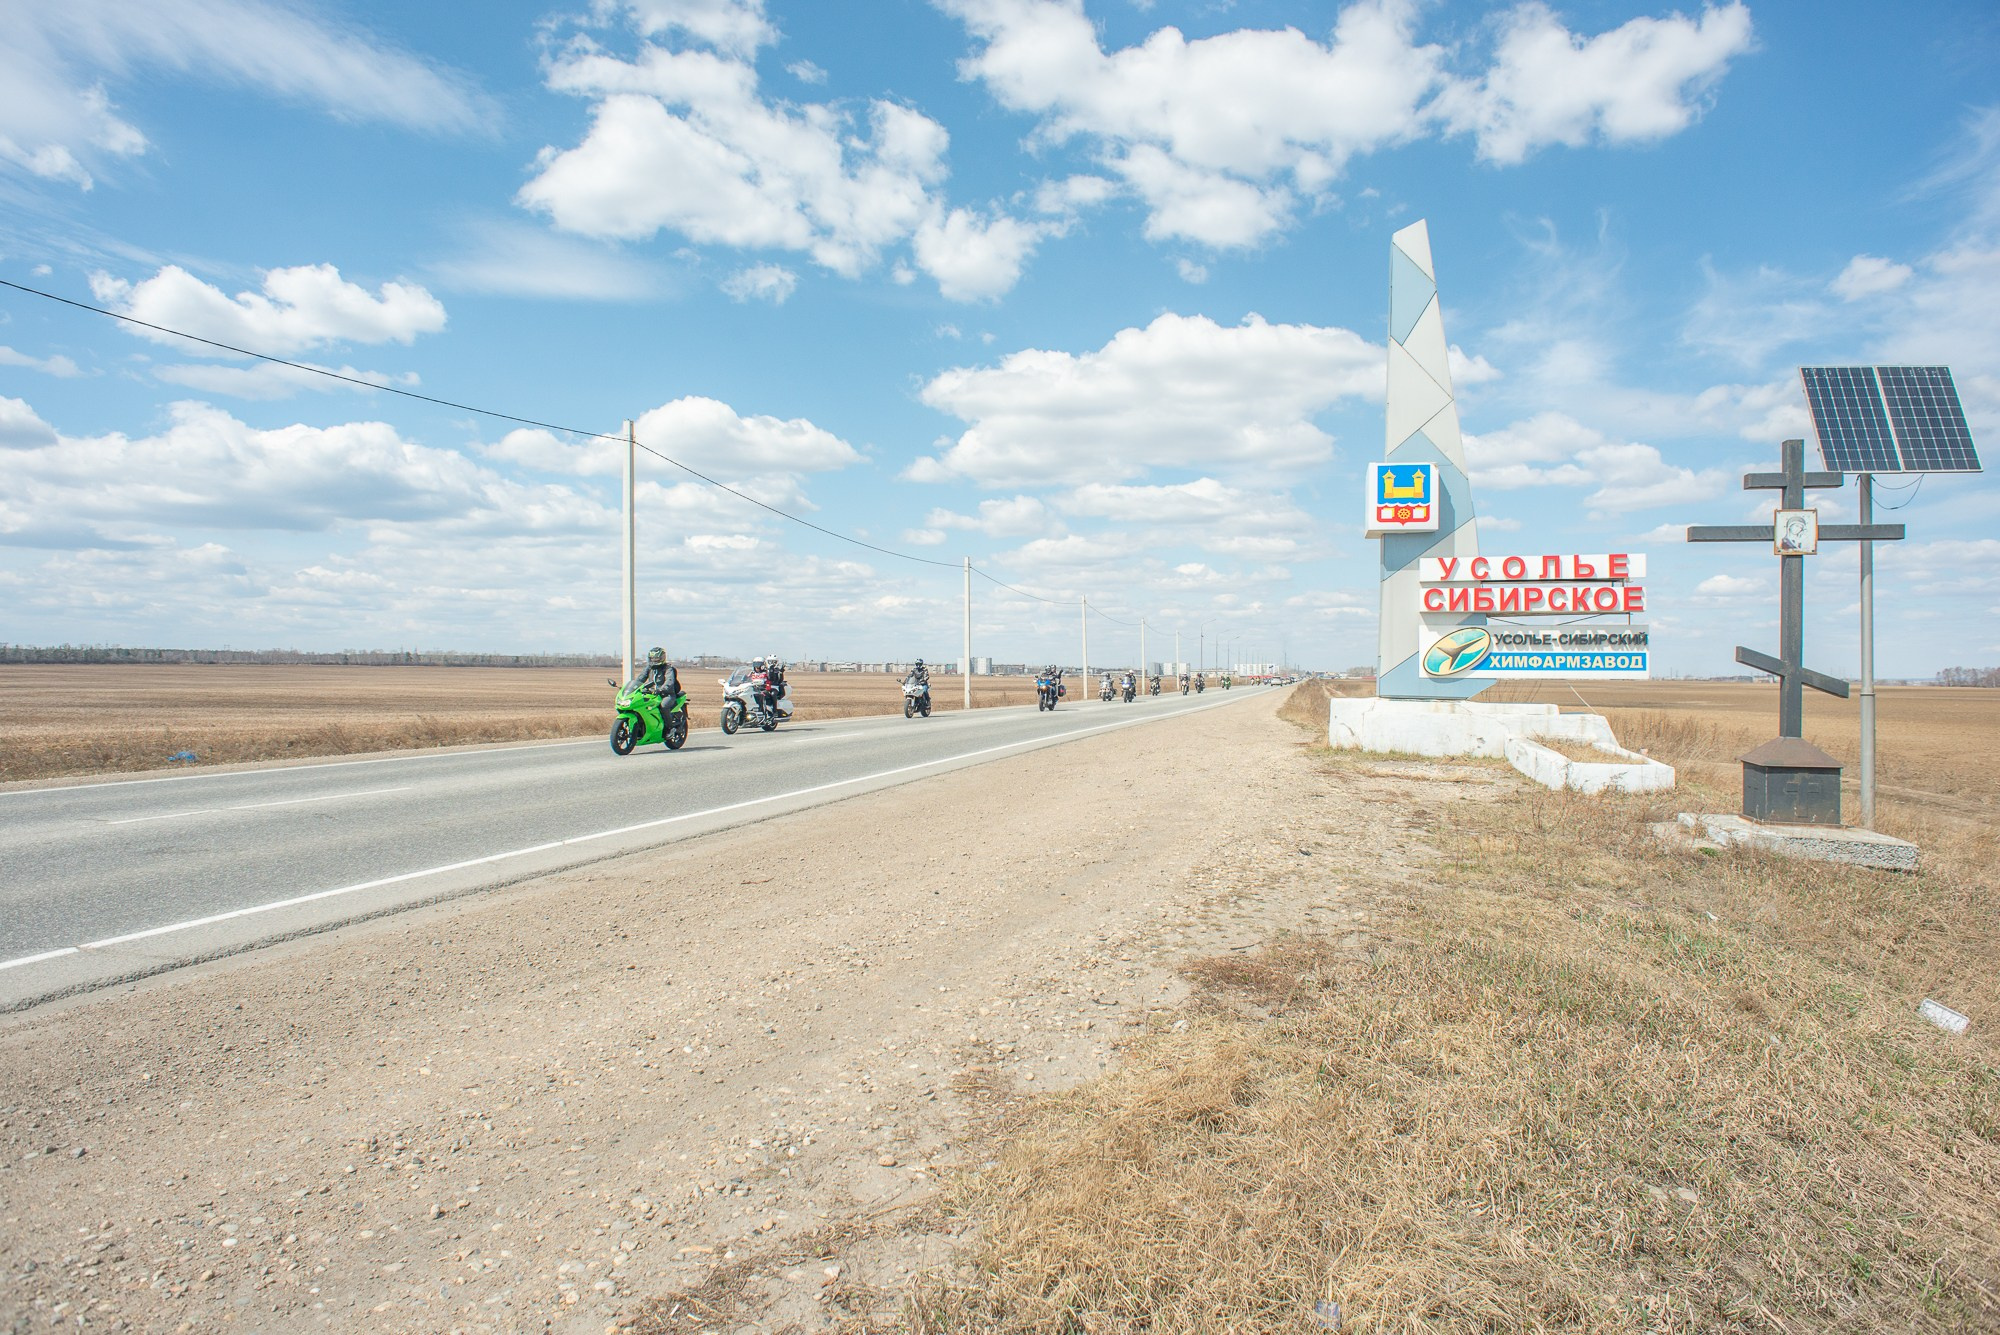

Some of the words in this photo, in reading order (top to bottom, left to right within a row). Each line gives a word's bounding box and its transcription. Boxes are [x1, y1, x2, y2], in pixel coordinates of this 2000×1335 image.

[1437, 554, 1628, 580] УСОЛЬЕ
[1423, 586, 1644, 612] СИБИРСКОЕ
[1494, 631, 1648, 646] УСОЛЬЕ-СИБИРСКИЙ
[1489, 655, 1644, 669] ХИМФАРМЗАВОД
